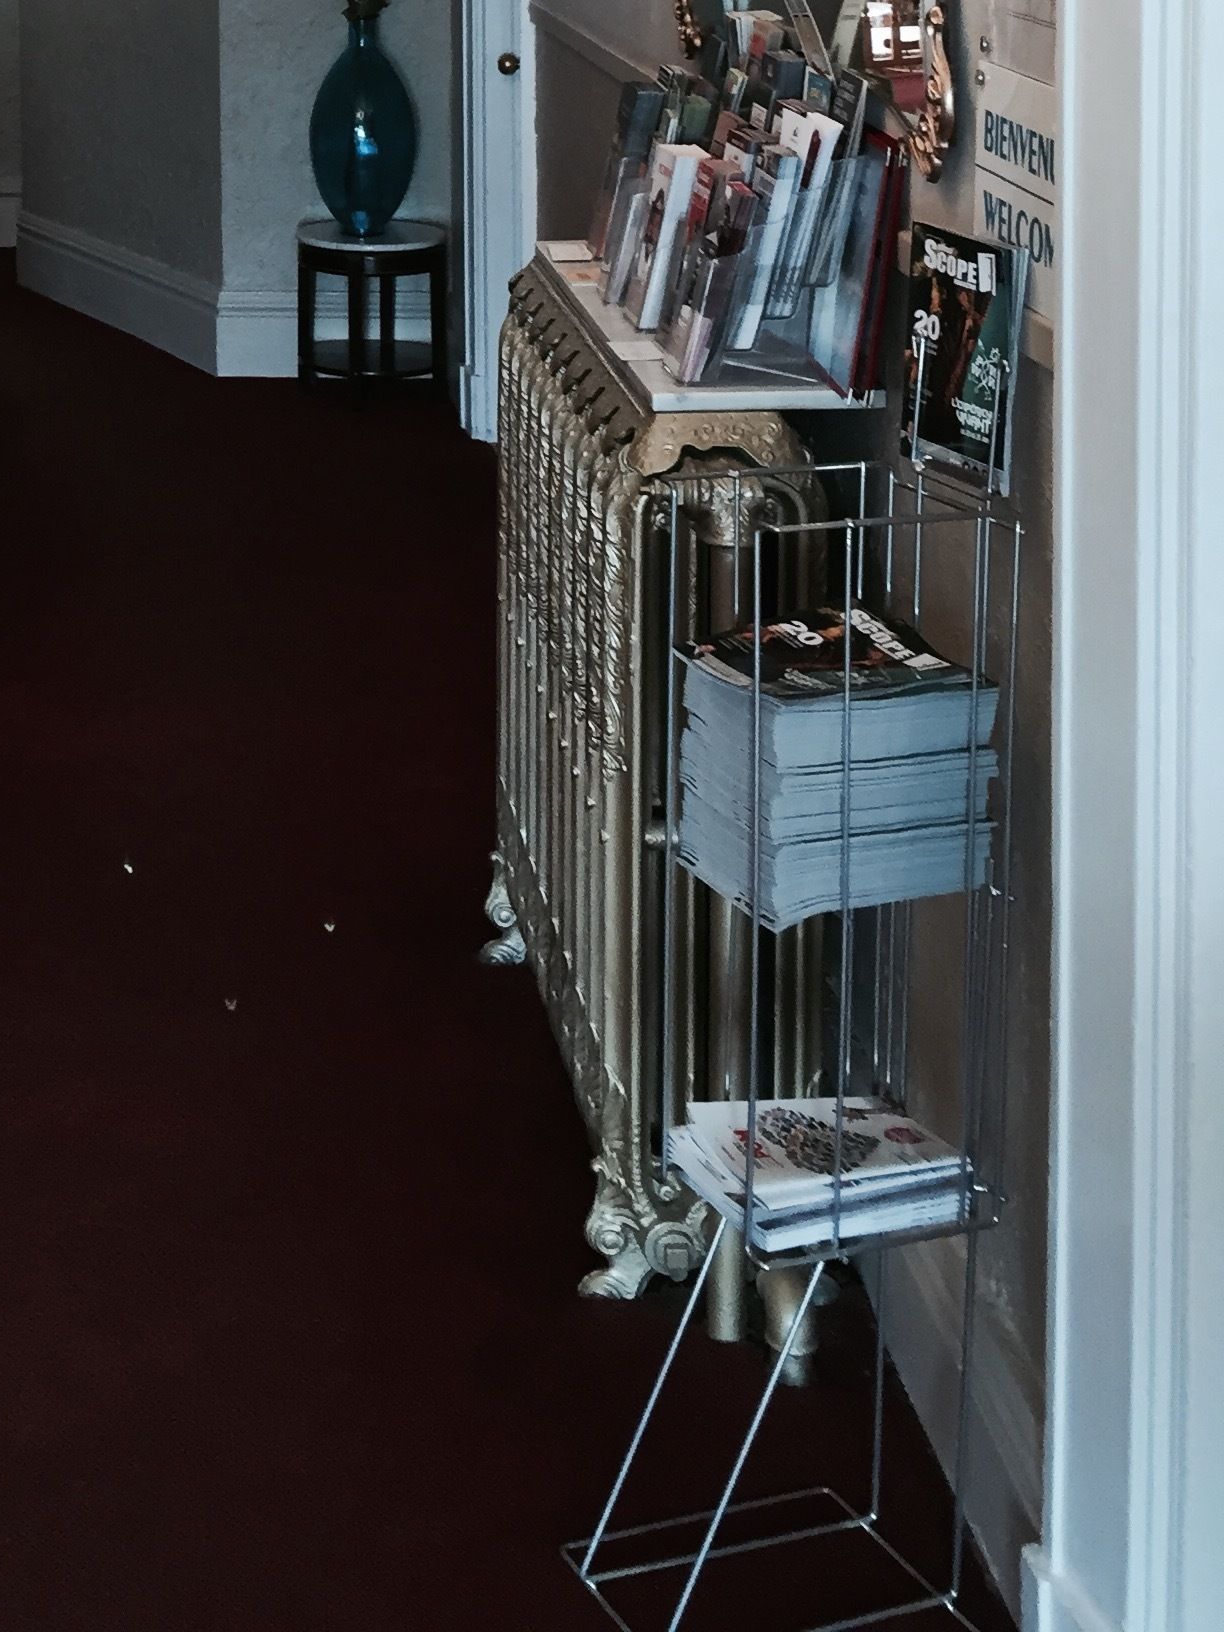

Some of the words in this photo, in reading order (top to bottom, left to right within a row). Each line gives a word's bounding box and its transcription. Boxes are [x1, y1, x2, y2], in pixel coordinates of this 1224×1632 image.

[923, 238, 977, 285] SCOPE
[913, 309, 941, 341] 20
[778, 620, 824, 646] 20
